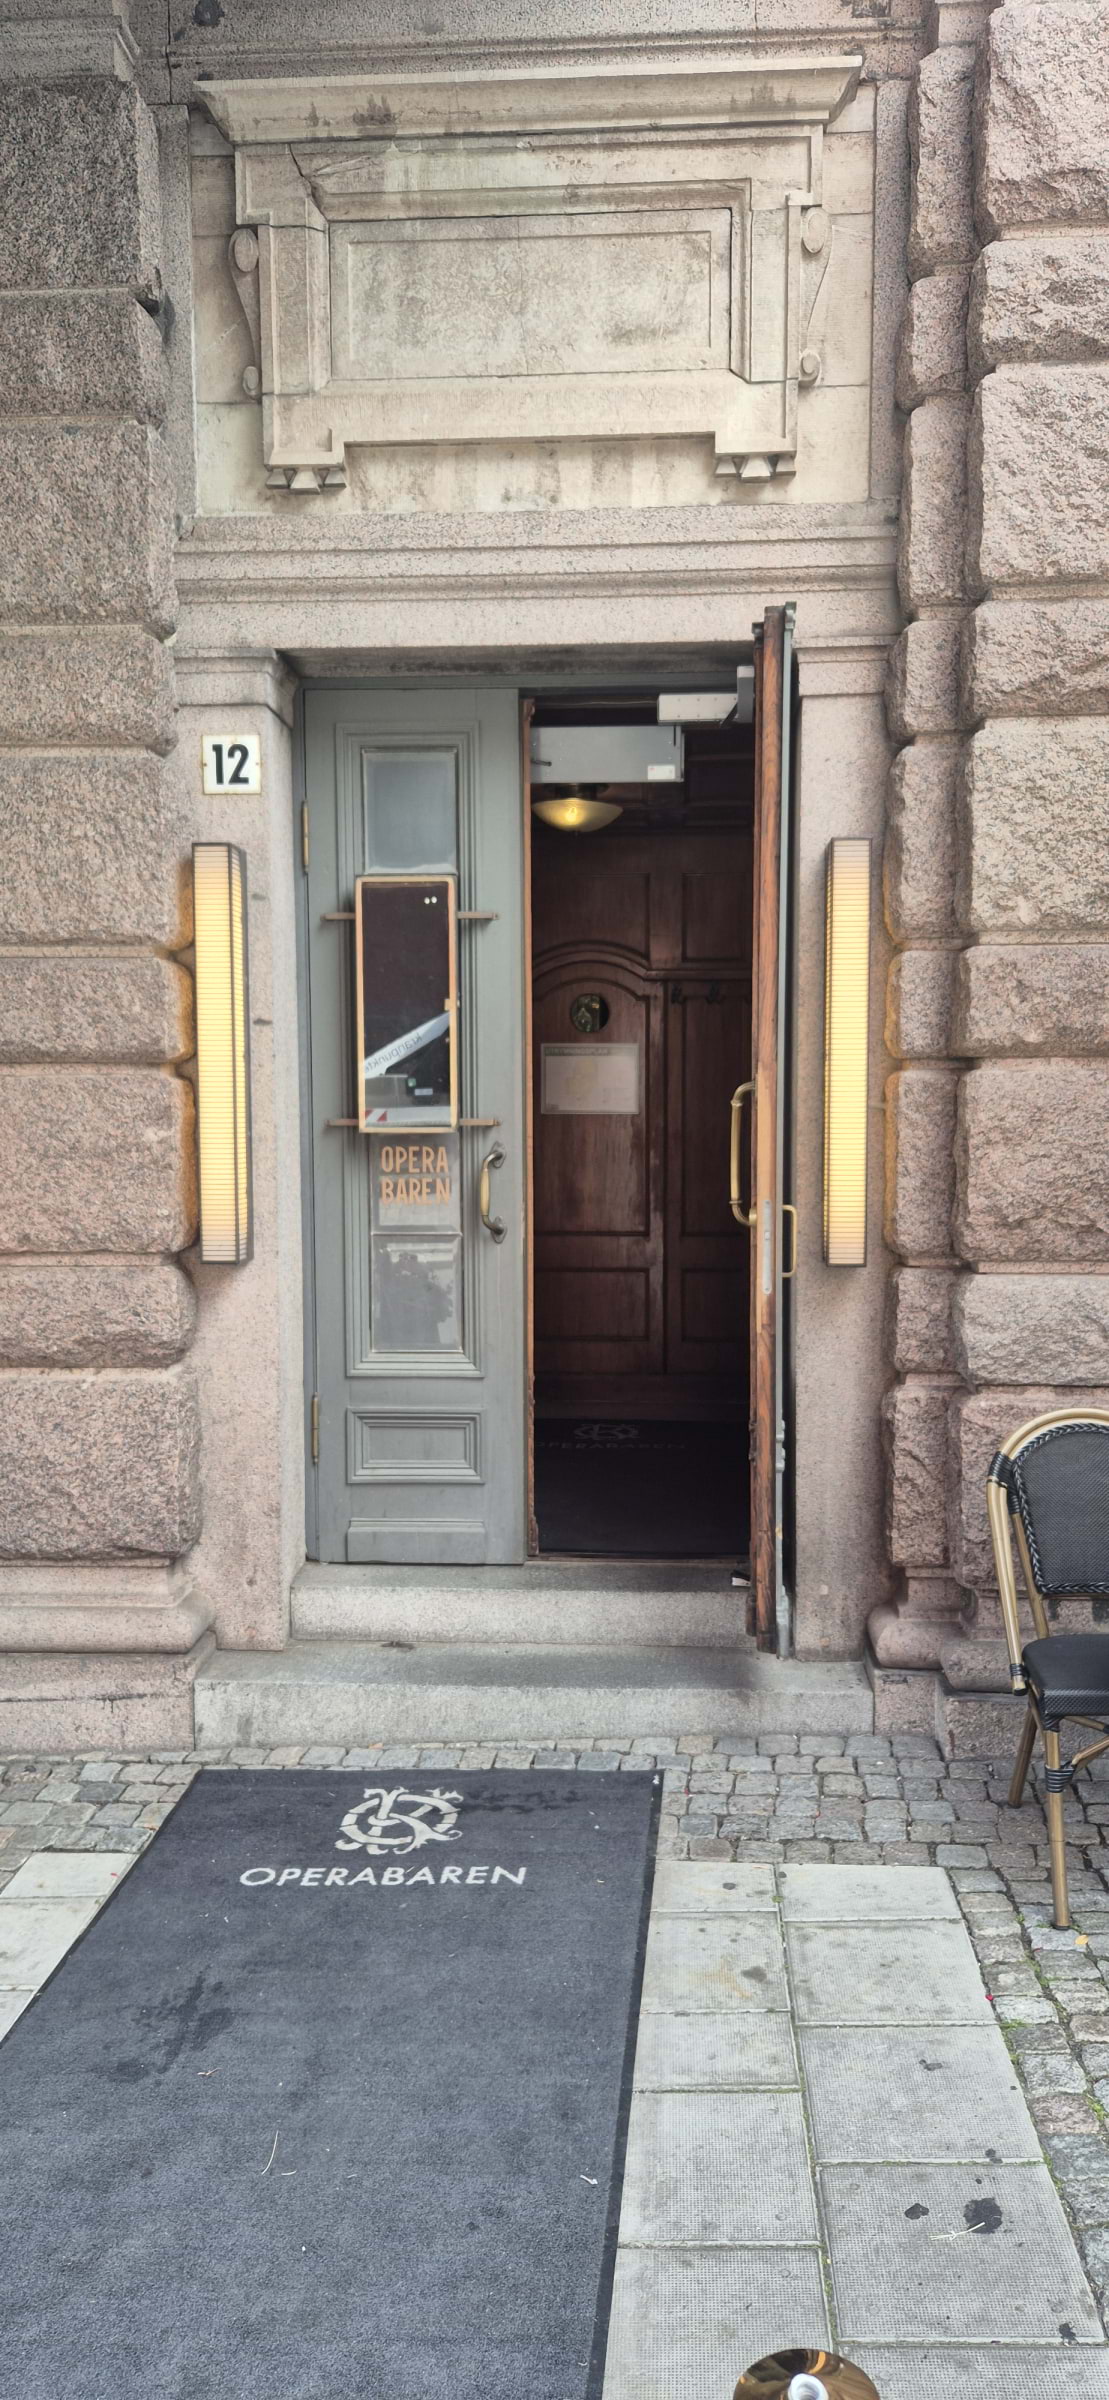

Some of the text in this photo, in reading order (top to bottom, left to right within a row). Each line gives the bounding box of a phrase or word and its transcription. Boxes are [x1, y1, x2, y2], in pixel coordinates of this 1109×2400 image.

[212, 743, 250, 785] 12
[381, 1145, 449, 1173] OPERA
[381, 1176, 450, 1205] BAREN
[239, 1865, 527, 1887] OPERABAREN
